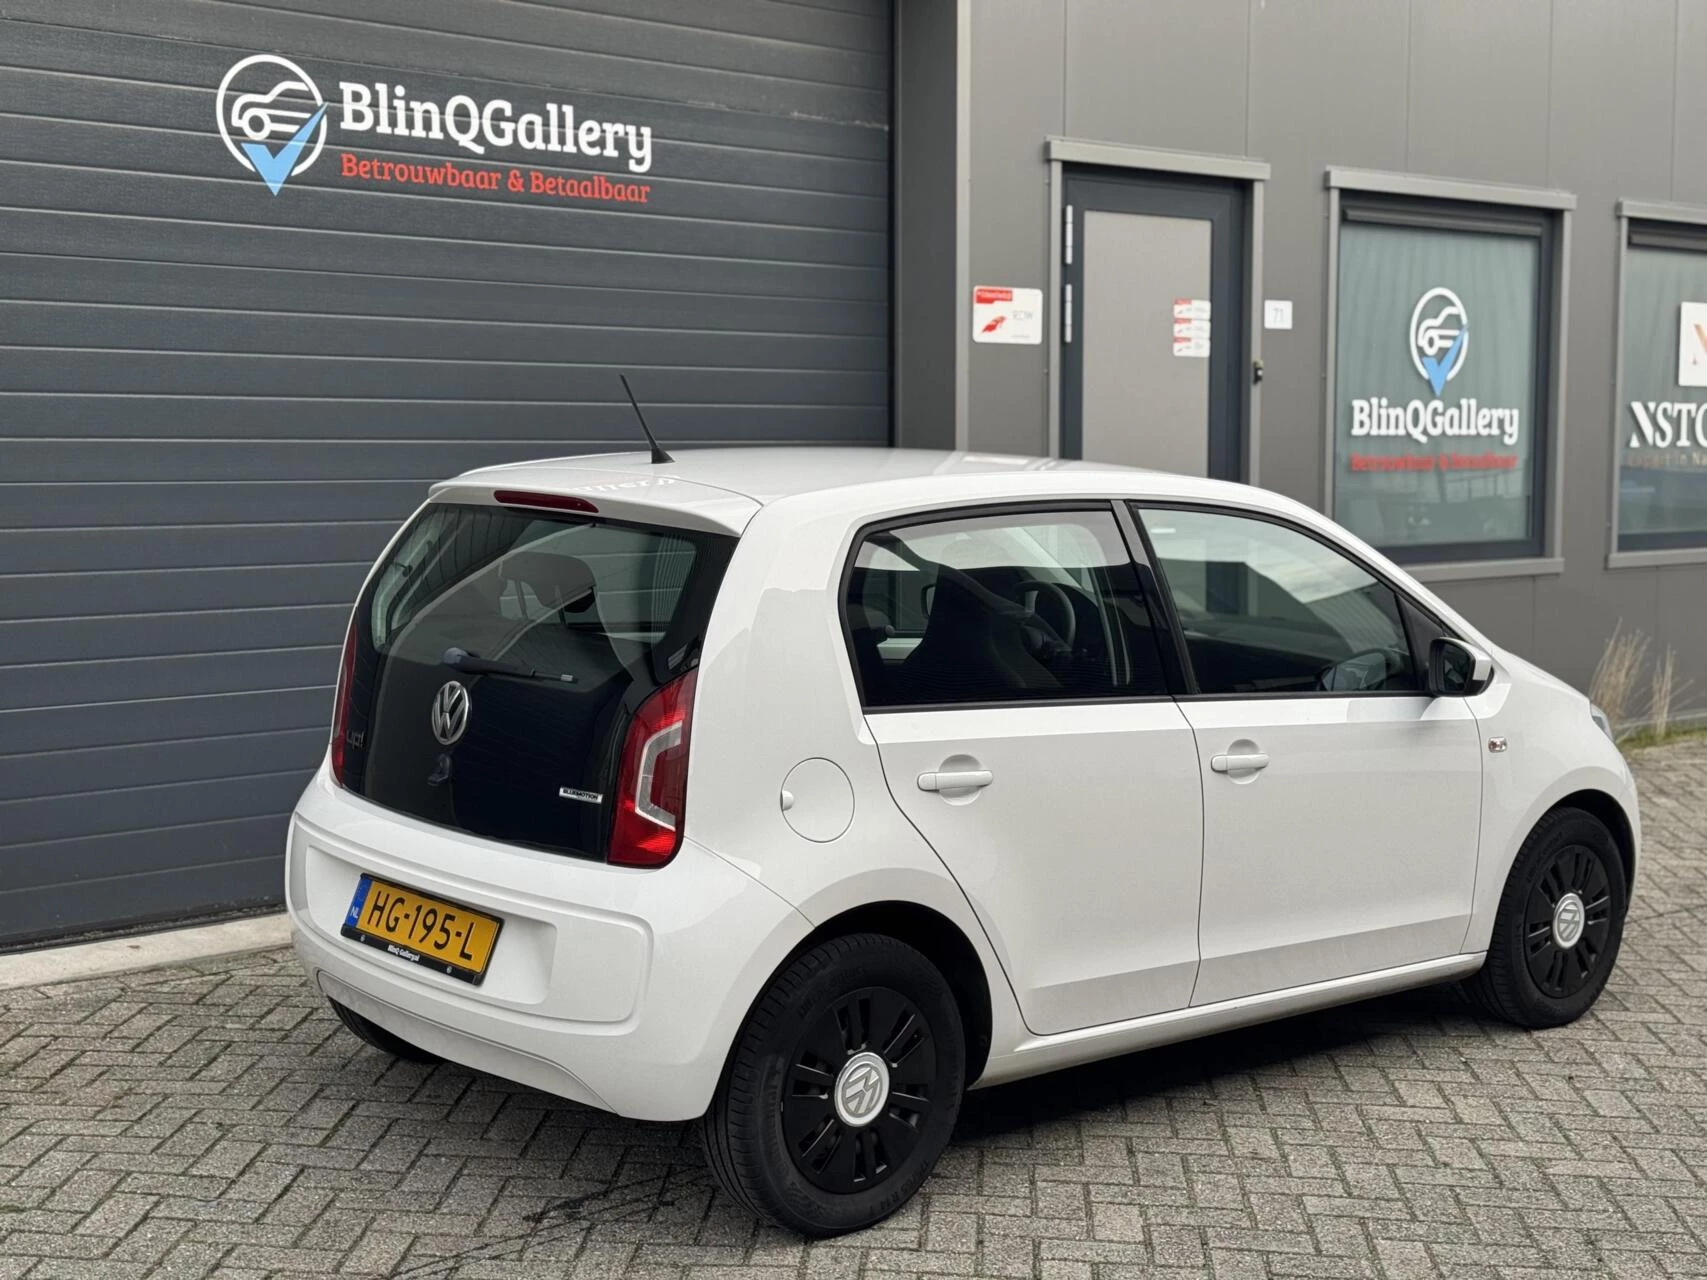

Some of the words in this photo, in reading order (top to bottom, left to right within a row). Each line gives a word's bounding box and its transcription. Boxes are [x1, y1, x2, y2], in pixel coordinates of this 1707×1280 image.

[339, 81, 653, 174] BlinQGallery
[340, 153, 502, 191] Betrouwbaar
[507, 172, 524, 193] &
[529, 172, 651, 204] Betaalbaar
[1351, 396, 1520, 446] BlinQGallery
[367, 890, 473, 961] HG-195-L
